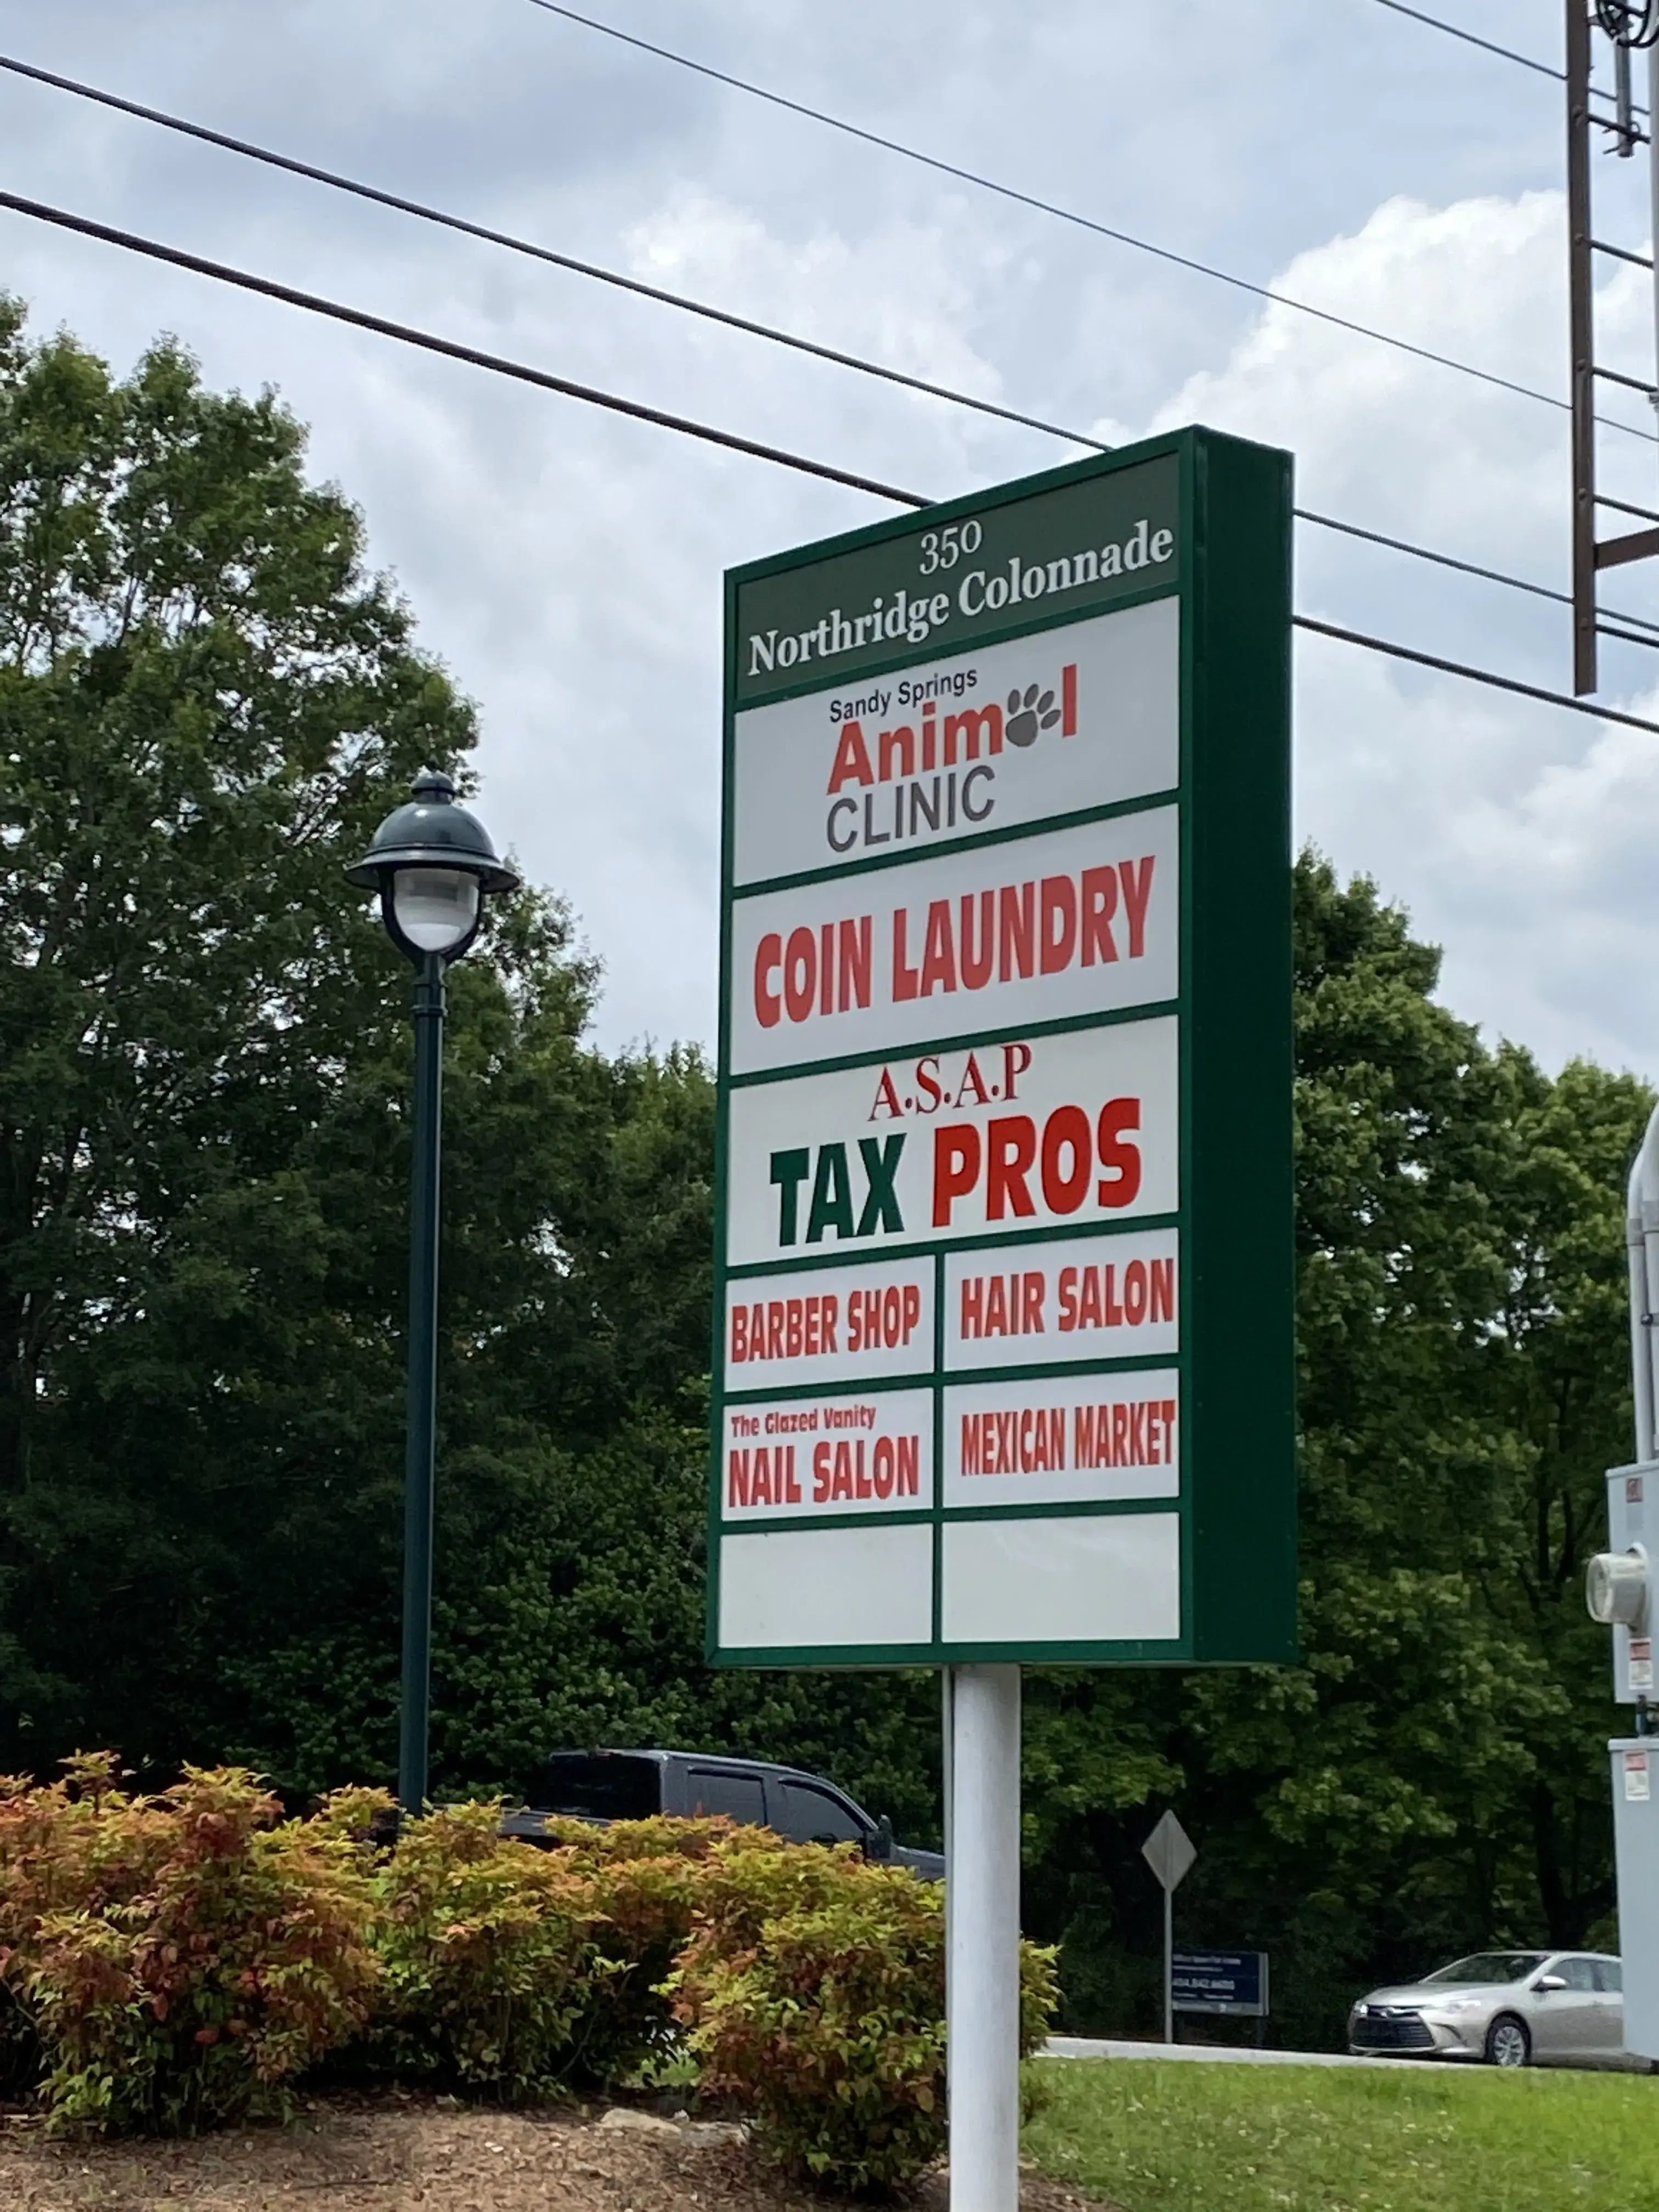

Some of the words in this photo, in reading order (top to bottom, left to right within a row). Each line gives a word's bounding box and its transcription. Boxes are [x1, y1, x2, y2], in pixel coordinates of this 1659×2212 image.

[919, 519, 984, 575] 350
[748, 590, 950, 676] Northridge
[958, 519, 1173, 616] Colonnade
[827, 664, 1077, 795] Animl
[830, 689, 891, 724] Sandy
[898, 669, 978, 706] Springs
[827, 765, 996, 853] CLINIC
[755, 916, 872, 1028] COIN
[893, 856, 1154, 1002] LAUNDRY
[868, 1043, 1031, 1121] A.S.A.P
[770, 1133, 907, 1248] TAX
[932, 1097, 1142, 1228] PROS
[731, 1295, 838, 1363] BARBER
[848, 1285, 920, 1351] SHOP
[961, 1271, 1045, 1339] HAIR
[1058, 1259, 1174, 1331] SALON
[731, 1415, 759, 1437] The
[765, 1409, 818, 1434] Glazed
[823, 1405, 876, 1430] Vanity
[961, 1408, 1065, 1476] MEXICAN
[1075, 1400, 1175, 1469] MARKET
[729, 1446, 802, 1507] NAIL
[813, 1436, 919, 1503] SALON
